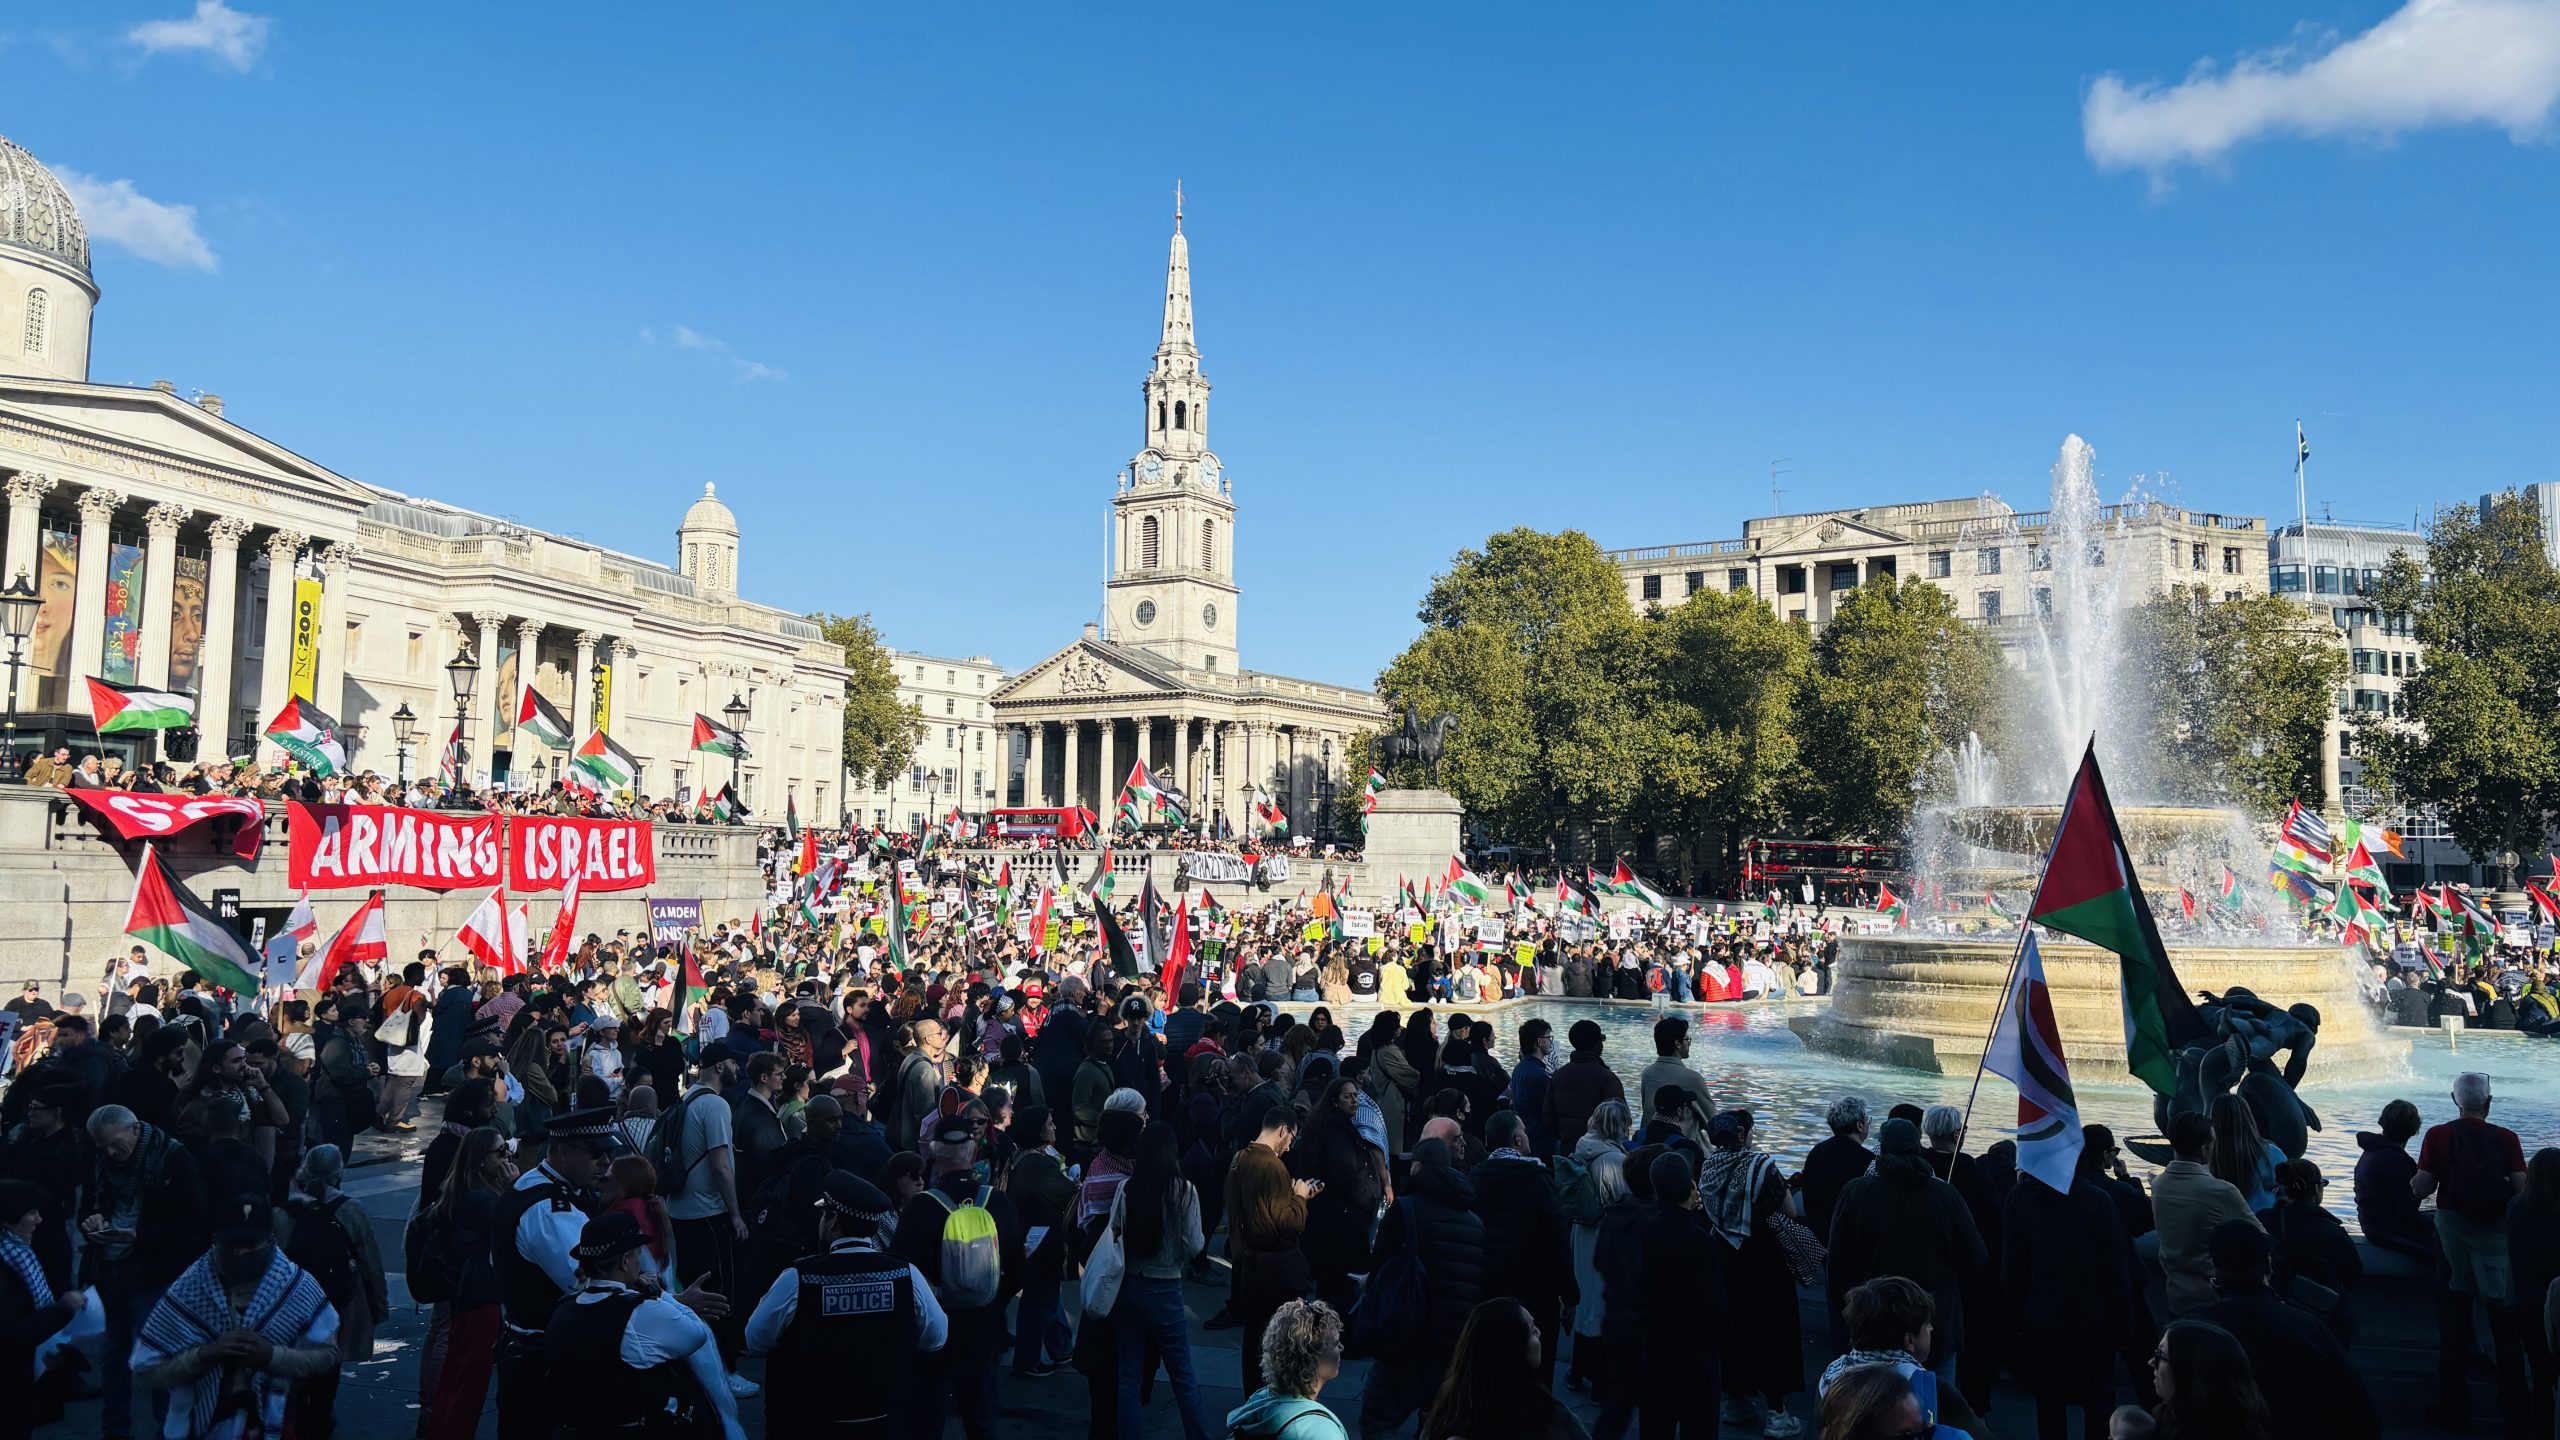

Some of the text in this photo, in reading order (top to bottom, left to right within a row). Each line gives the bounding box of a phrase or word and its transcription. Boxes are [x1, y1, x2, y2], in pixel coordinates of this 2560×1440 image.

[58, 444, 168, 482] NATIONAL
[184, 475, 271, 503] GALLERY
[295, 600, 311, 678] NG200
[280, 739, 323, 770] PALESTINE
[310, 811, 498, 878] ARMING
[524, 825, 643, 880] ISRAEL
[653, 906, 697, 919] CAMDEN
[1482, 928, 1501, 938] NOW!
[825, 1292, 891, 1313] POLICE
[826, 1284, 891, 1295] METROPOLITAN
